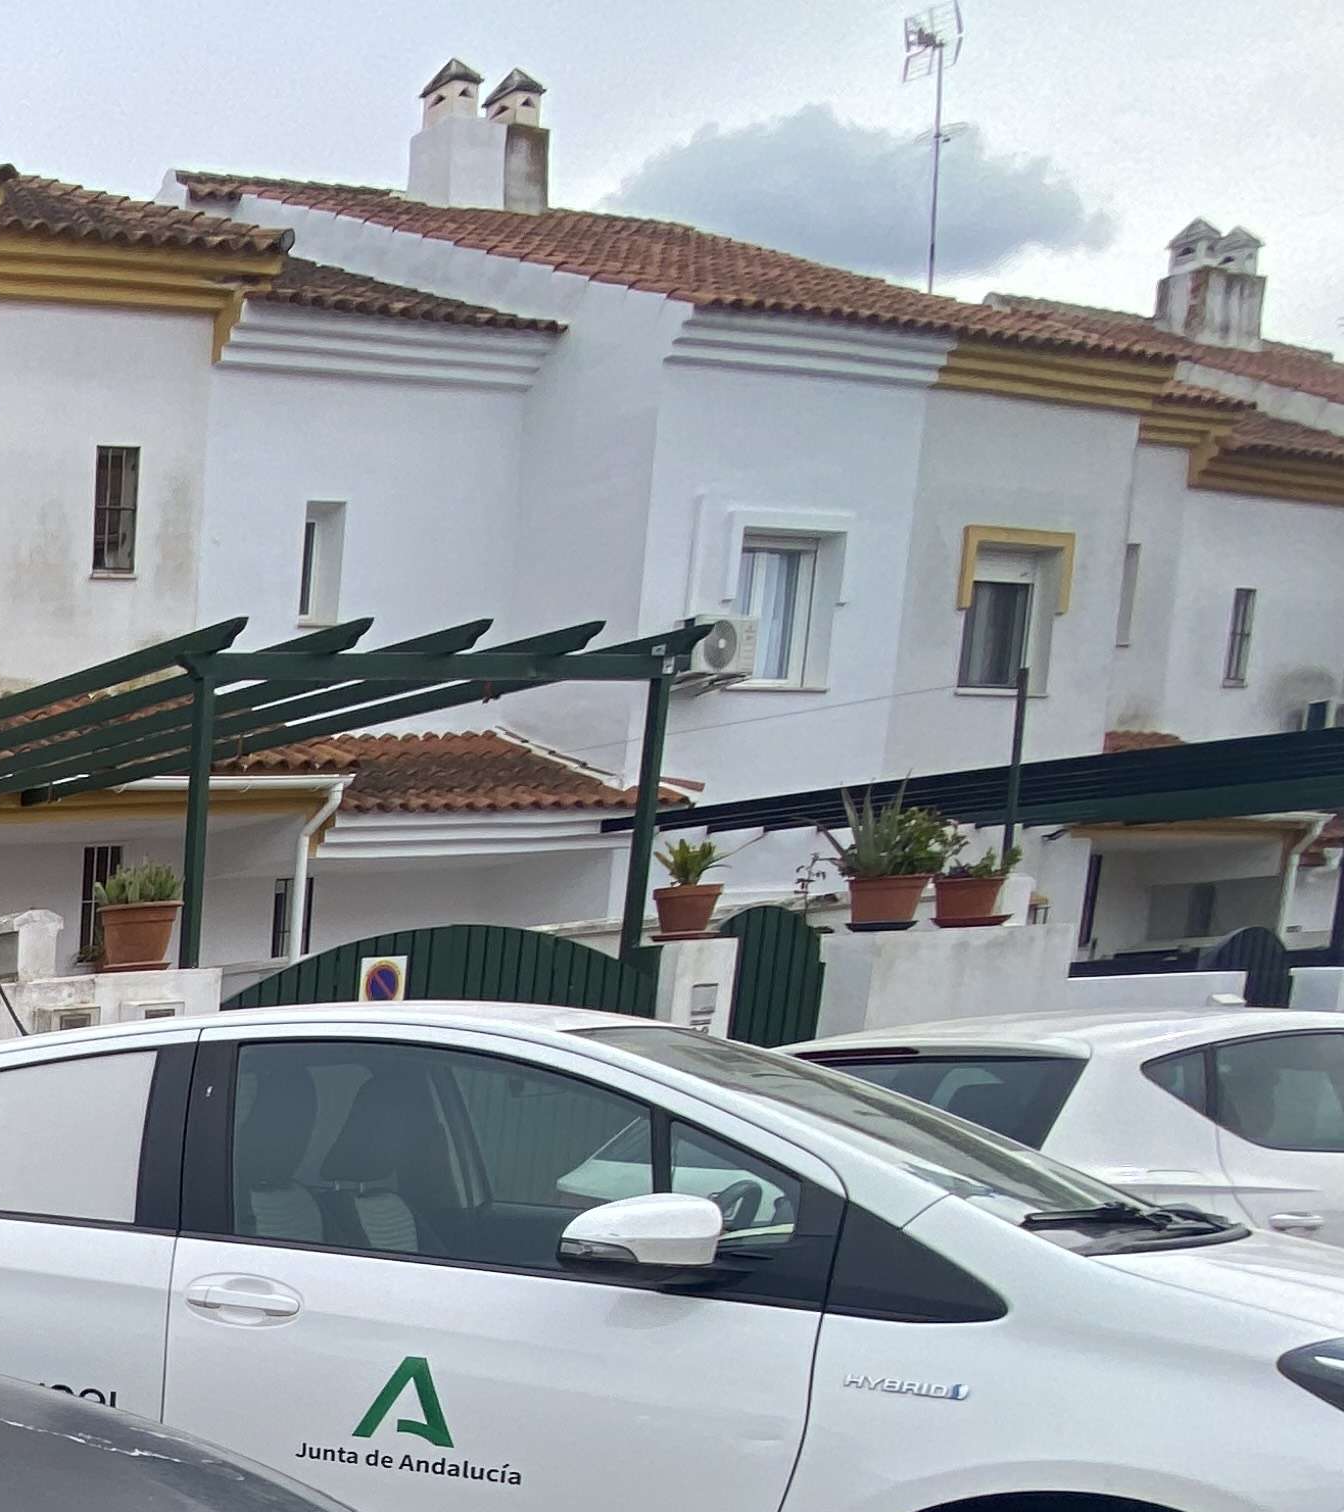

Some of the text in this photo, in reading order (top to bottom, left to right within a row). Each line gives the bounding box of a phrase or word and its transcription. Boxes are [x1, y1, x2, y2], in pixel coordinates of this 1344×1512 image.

[844, 1373, 948, 1399] HYBRID
[295, 1442, 522, 1485] Junta de Andalucía
